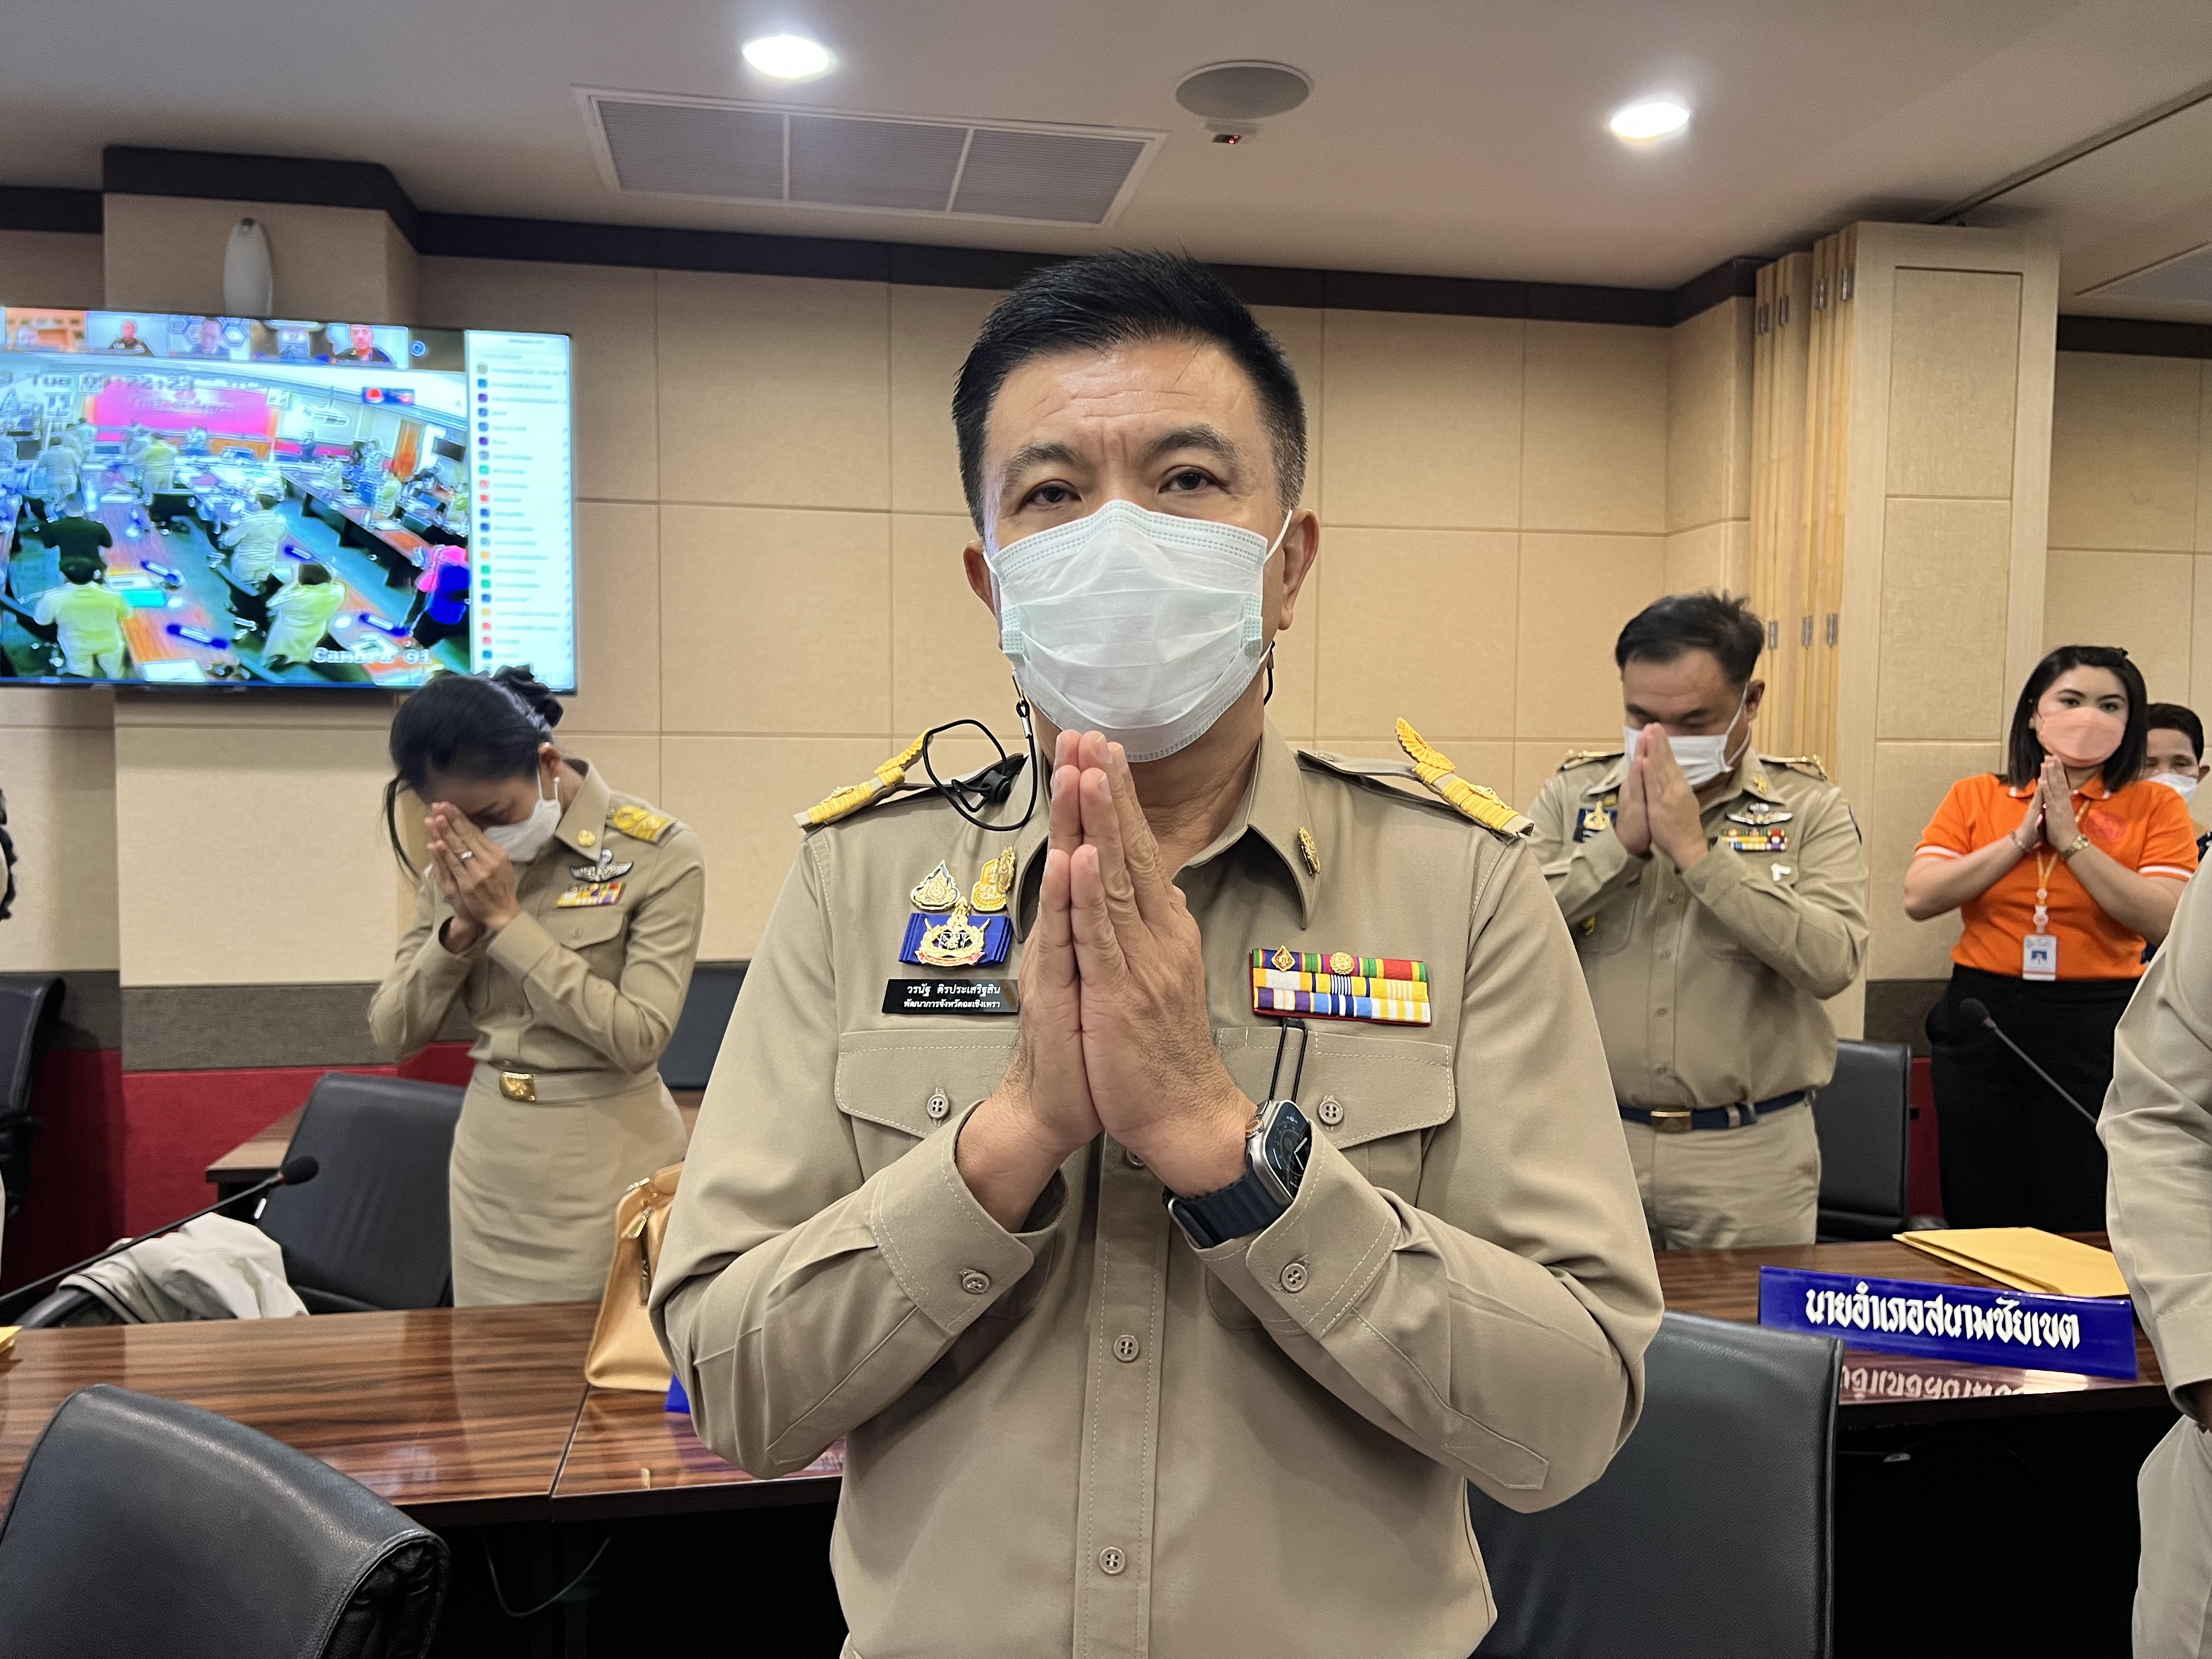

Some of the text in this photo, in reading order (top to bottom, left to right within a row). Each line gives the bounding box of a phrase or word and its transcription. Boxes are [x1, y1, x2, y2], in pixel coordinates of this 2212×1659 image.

[312, 647, 394, 664] Camea
[1805, 1281, 2080, 1349] นายอำเภอสนามชัยเขต
